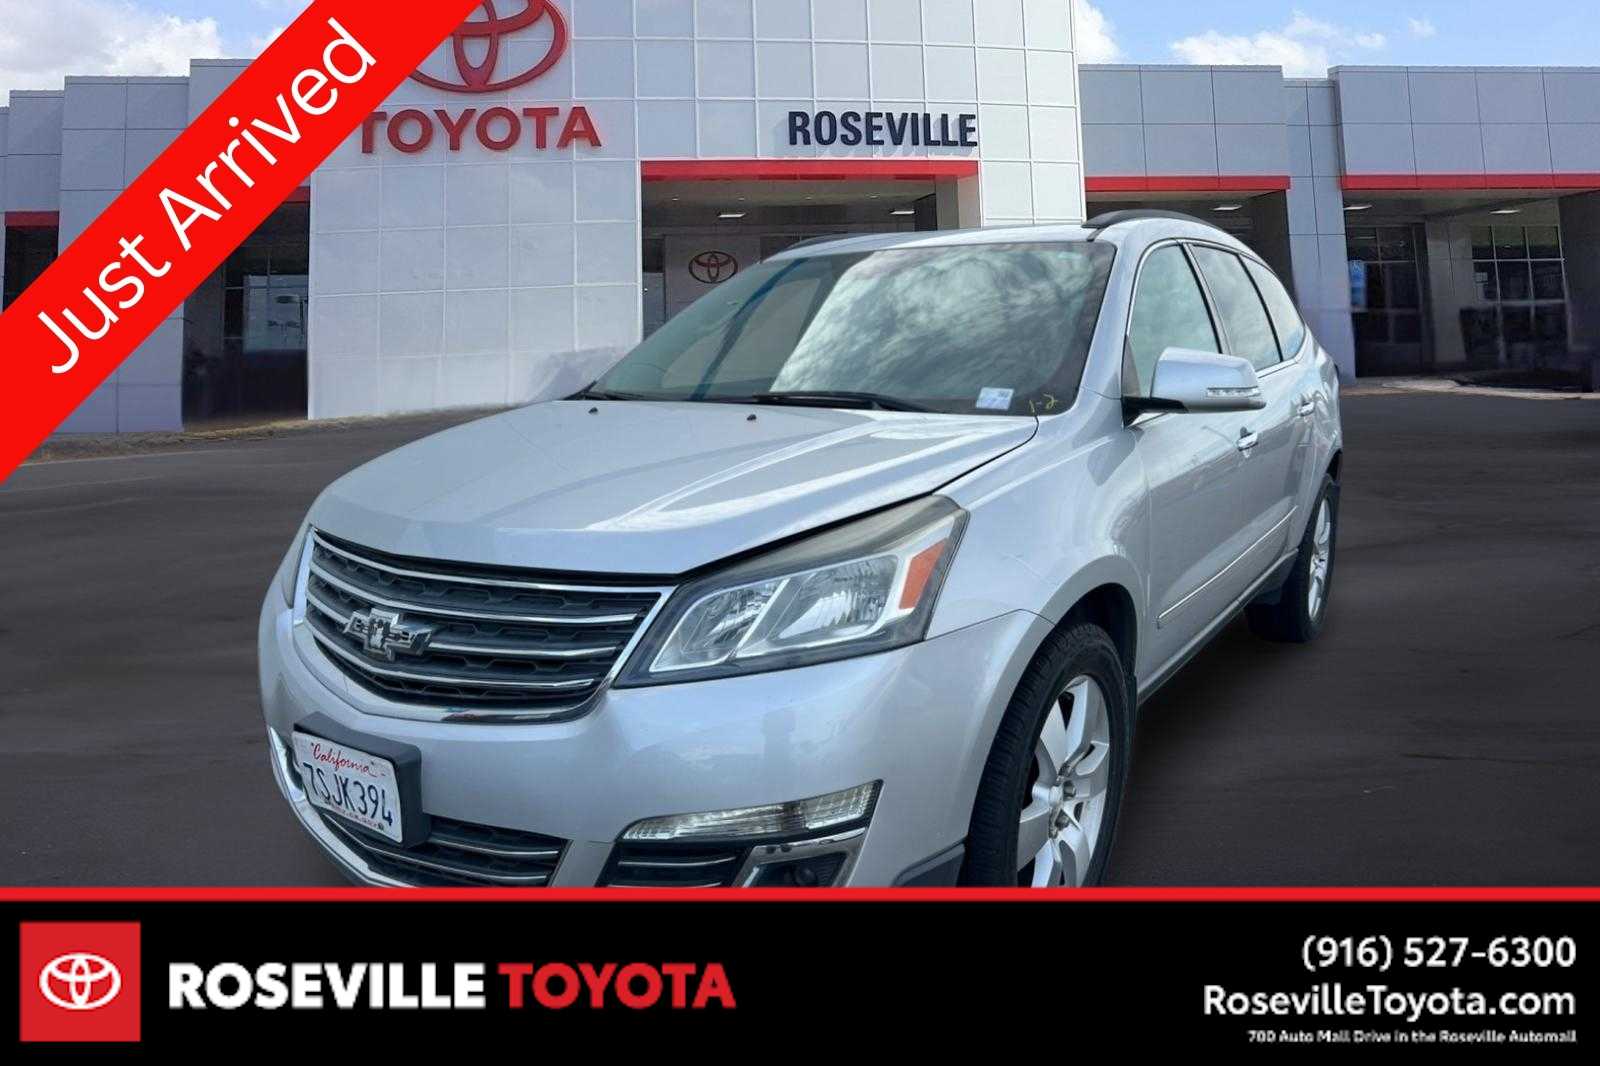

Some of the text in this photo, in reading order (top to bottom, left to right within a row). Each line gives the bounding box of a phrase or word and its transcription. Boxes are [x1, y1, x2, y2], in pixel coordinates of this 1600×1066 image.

[361, 106, 602, 154] TOYOTA
[788, 111, 978, 147] ROSEVILLE
[313, 743, 375, 776] California
[303, 762, 393, 826] 7SJK394
